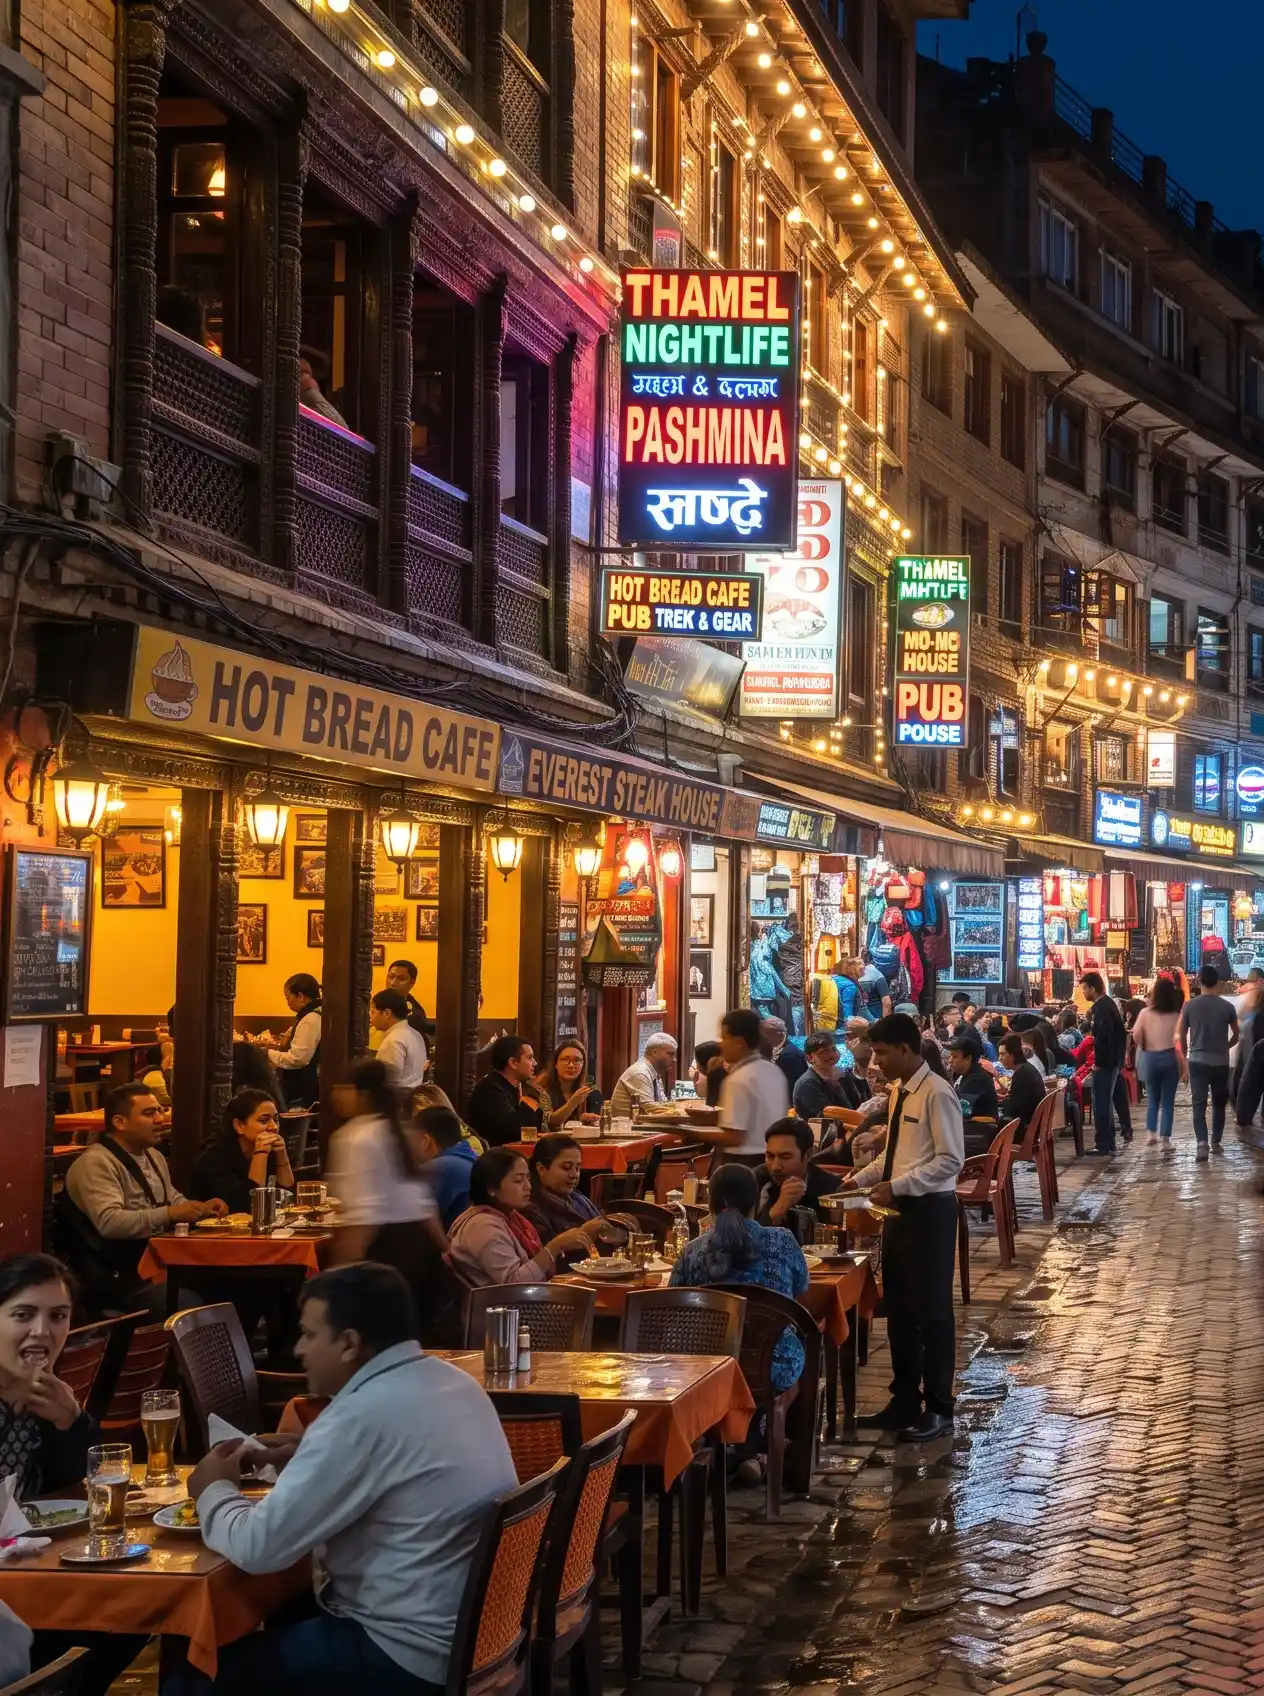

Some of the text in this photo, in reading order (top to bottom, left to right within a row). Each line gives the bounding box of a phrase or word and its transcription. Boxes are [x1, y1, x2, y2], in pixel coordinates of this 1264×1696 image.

[626, 274, 789, 320] THAMEL
[625, 324, 789, 365] NIGHTLIFE
[625, 406, 786, 465] PASHMINA
[899, 560, 967, 582] THAMEL
[610, 575, 750, 607] HOT BREAD CAFE
[607, 604, 752, 632] PUB TREK & GEAR
[903, 652, 958, 673] HOUSE
[209, 661, 495, 781] HOT BREAD CAFE
[898, 683, 964, 721] PUB
[899, 723, 961, 743] POUSE
[527, 748, 612, 807] EVEREST
[612, 769, 666, 818] STEAK
[668, 786, 720, 831] HOUSE
